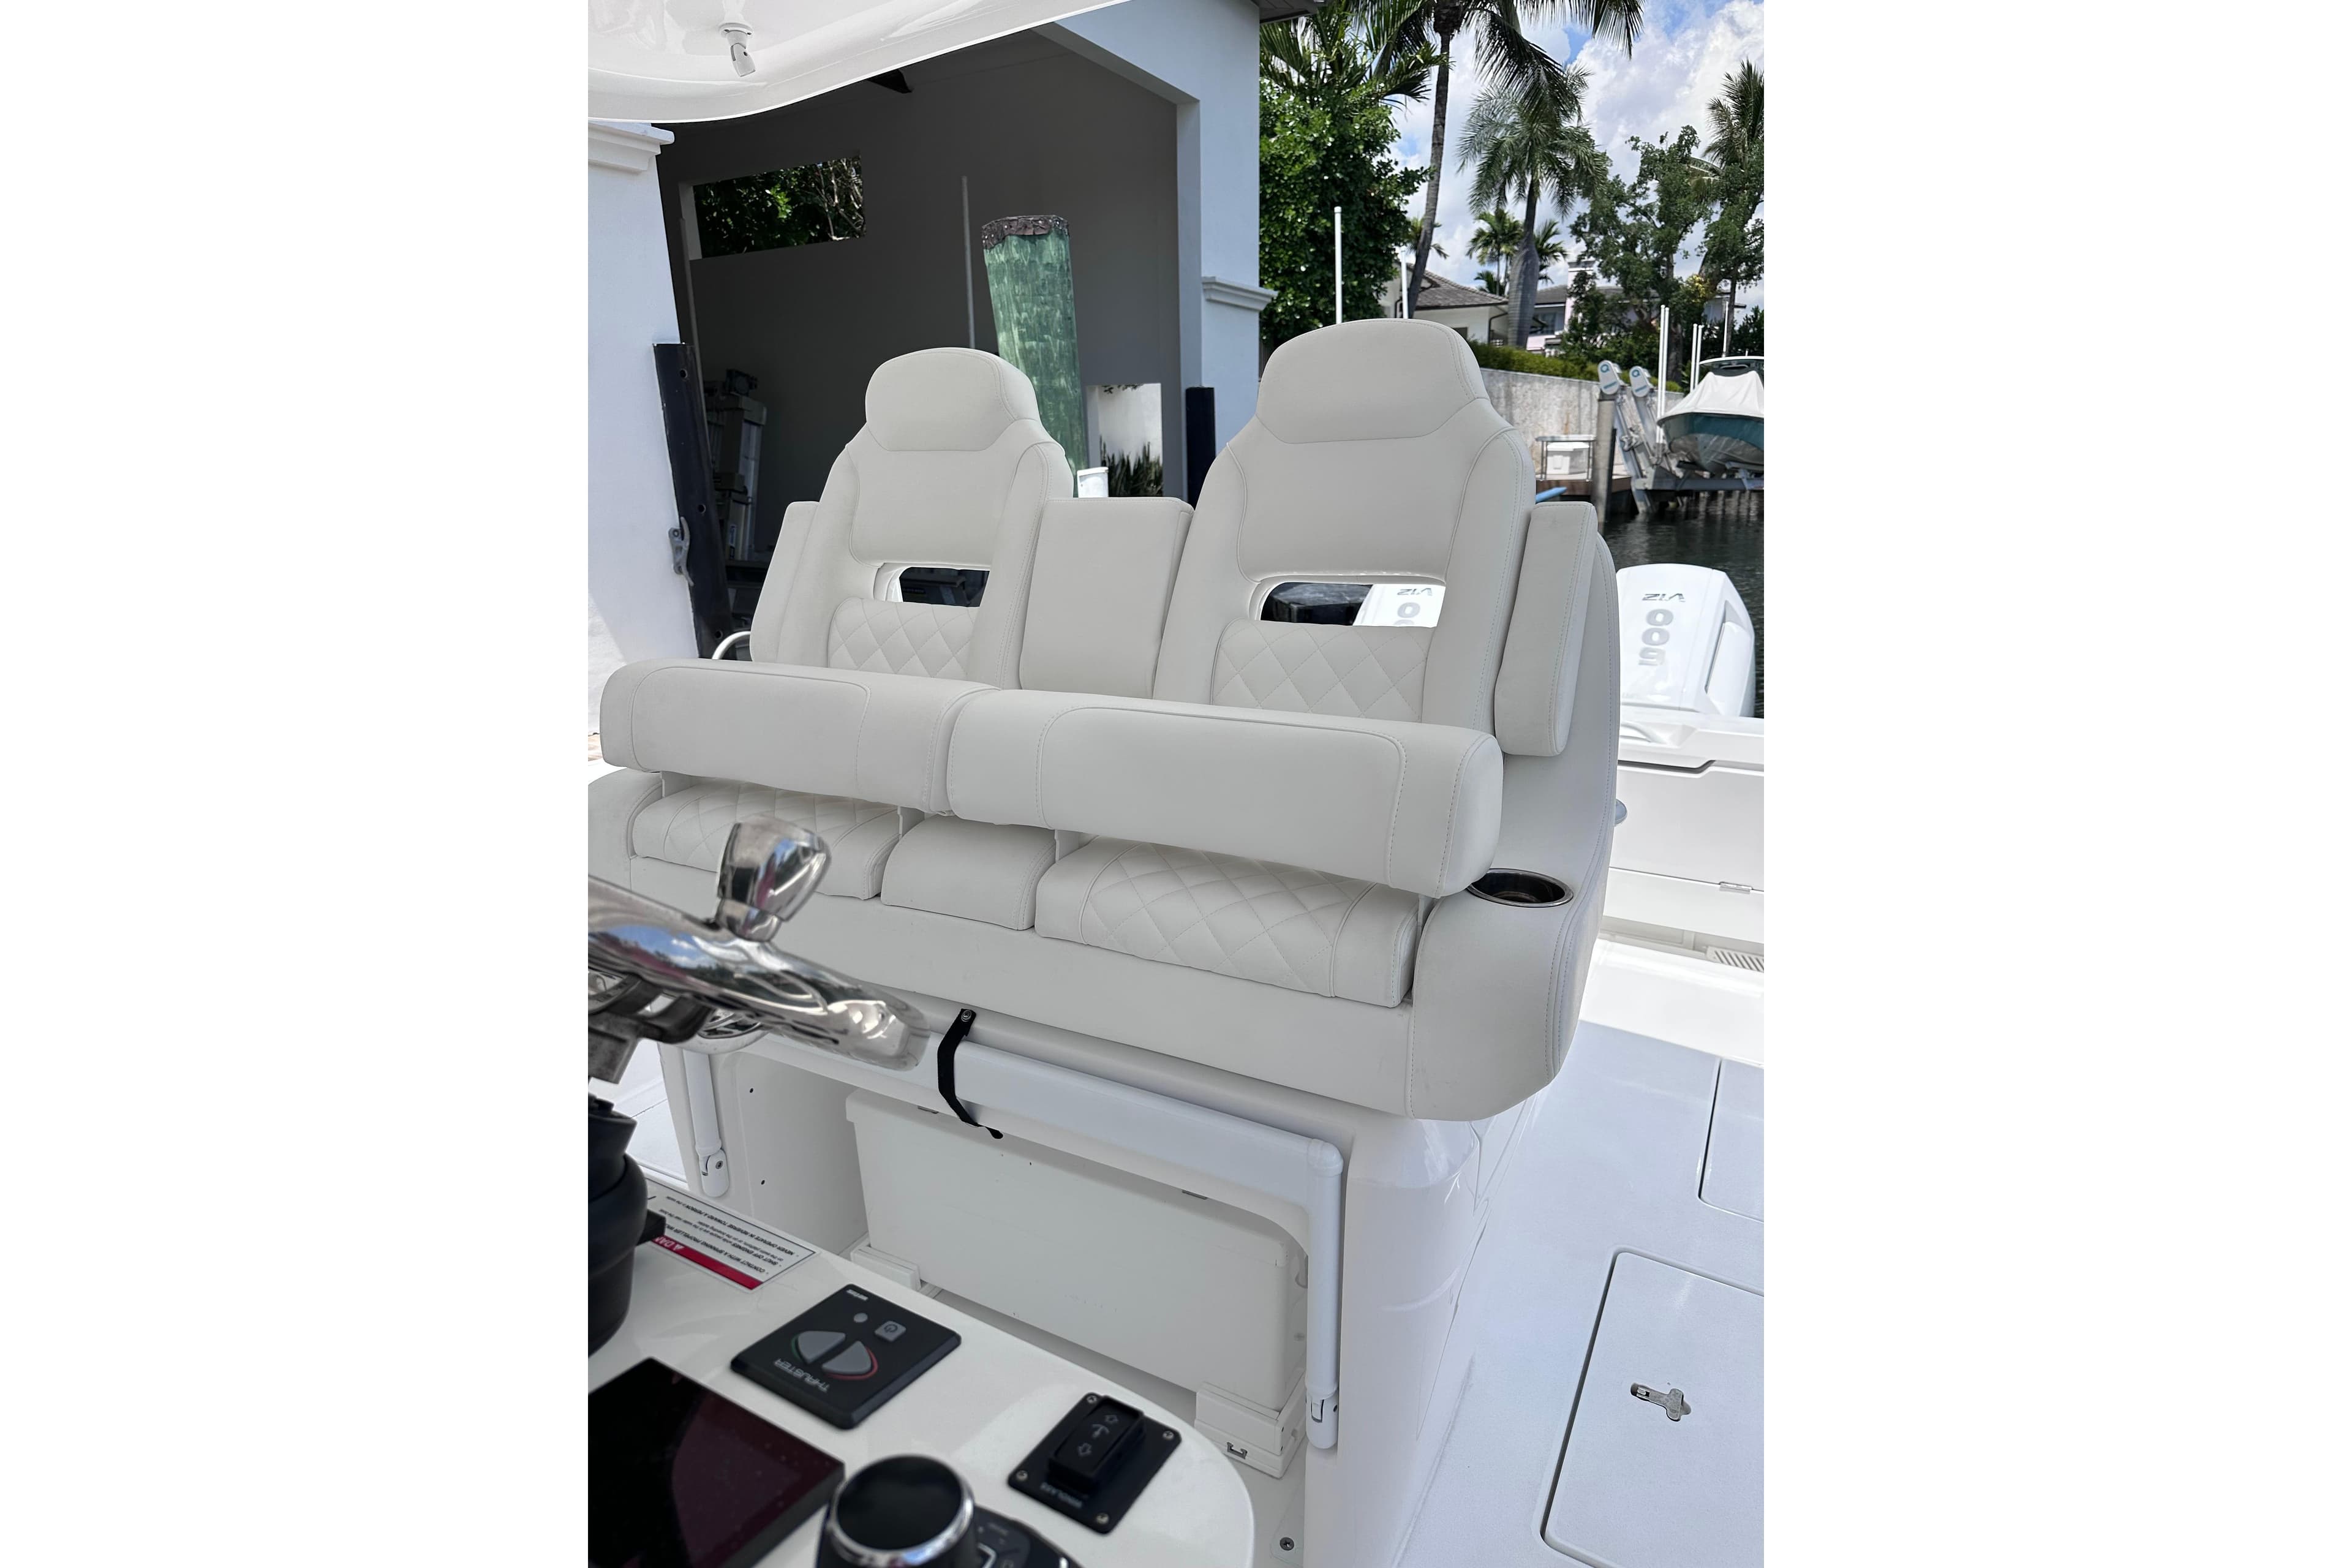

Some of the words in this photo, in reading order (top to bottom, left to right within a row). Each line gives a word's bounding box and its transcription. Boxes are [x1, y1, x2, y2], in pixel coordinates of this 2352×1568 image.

[685, 1205, 705, 1215] PERSON
[707, 1215, 728, 1226] TOWARD
[727, 1224, 750, 1235] REVERSE
[654, 1237, 675, 1246] DAN
[673, 1229, 702, 1243] PROPELLER
[754, 1236, 778, 1248] OPERATE
[701, 1242, 725, 1254] SPINNING
[731, 1243, 754, 1254] ENGINES
[777, 1246, 795, 1256] NEVER
[740, 1261, 766, 1273] CONTACT
[774, 1359, 830, 1392] THRUSTER
